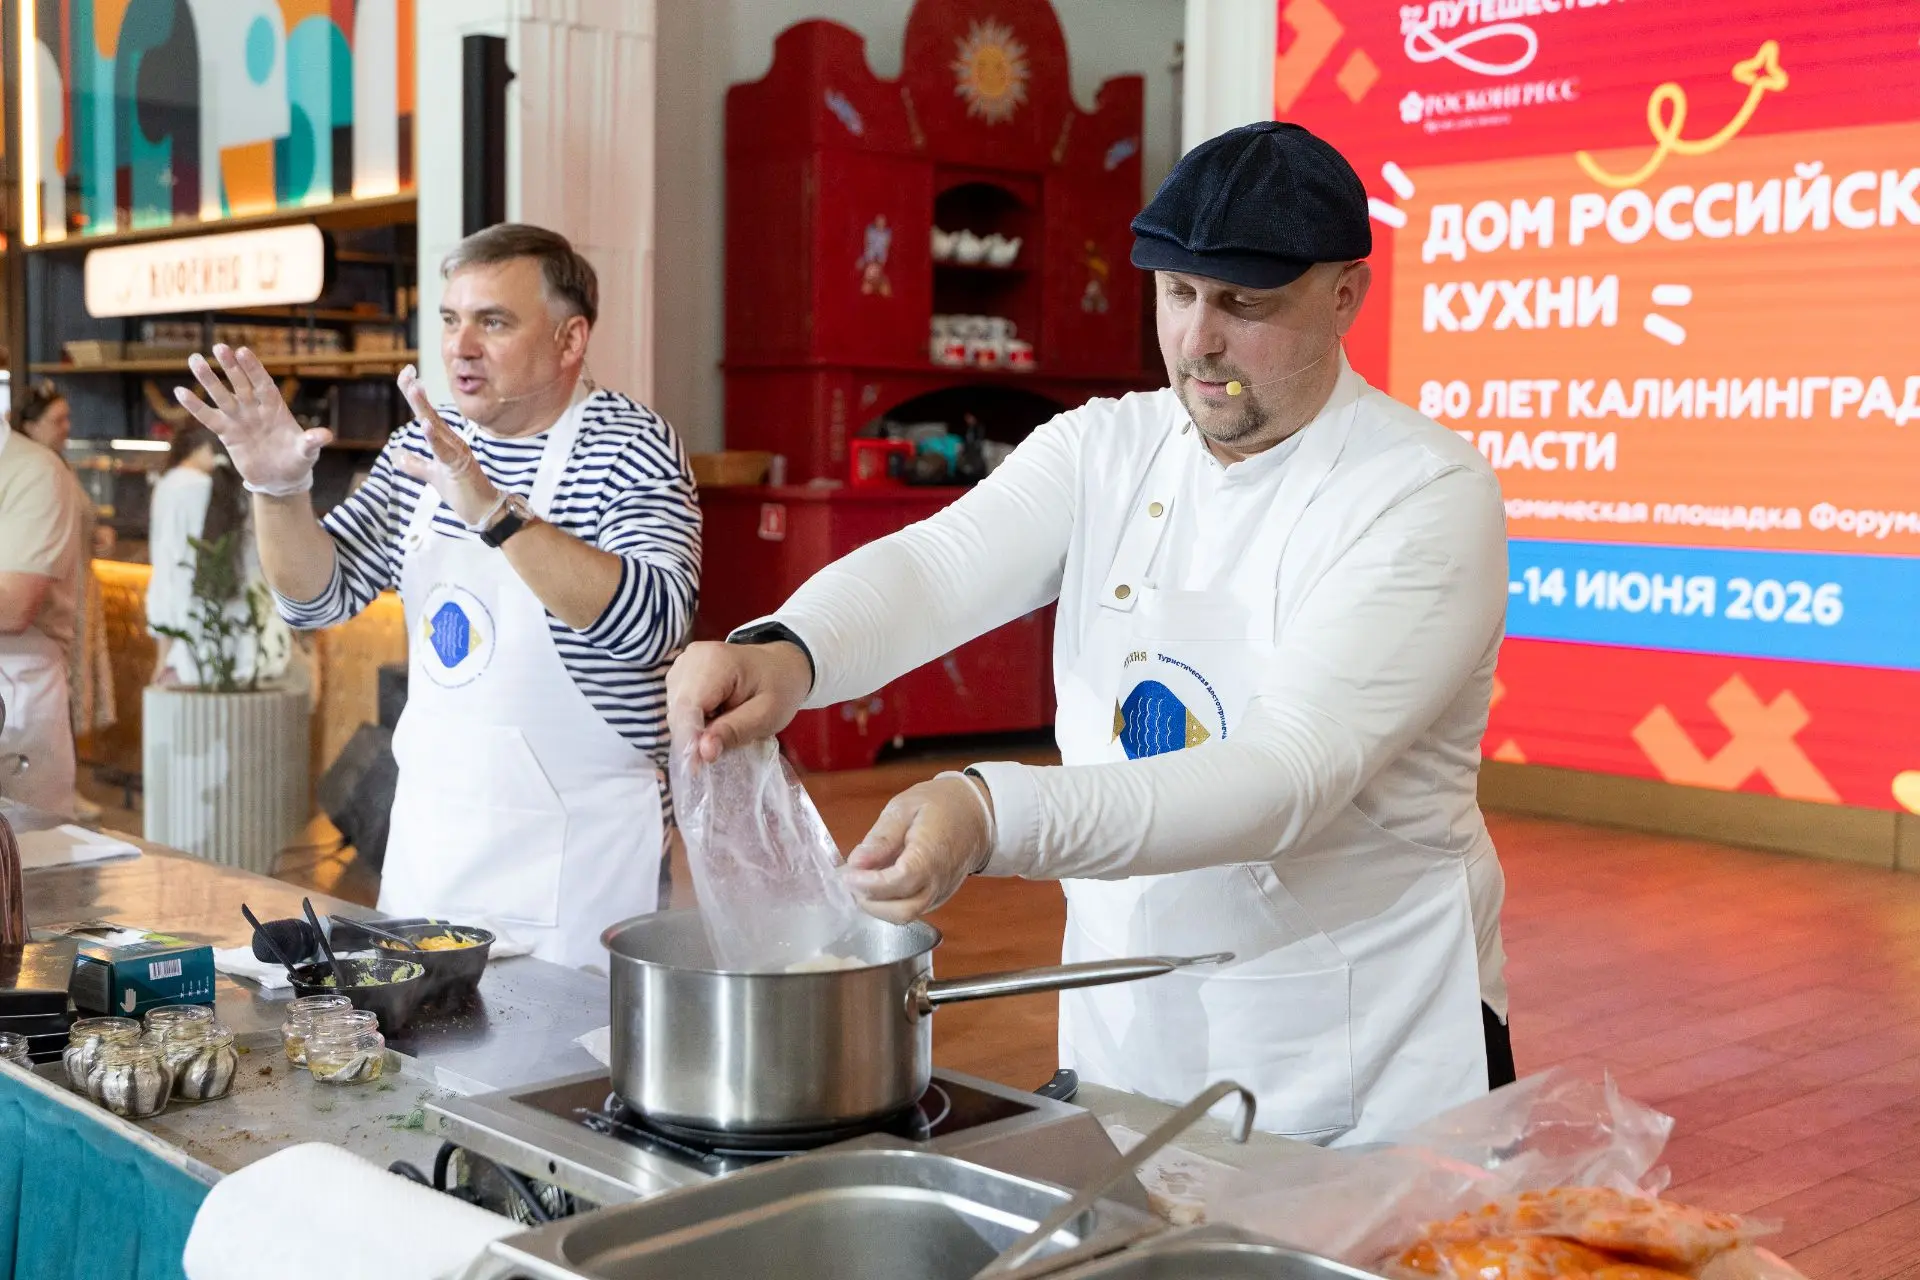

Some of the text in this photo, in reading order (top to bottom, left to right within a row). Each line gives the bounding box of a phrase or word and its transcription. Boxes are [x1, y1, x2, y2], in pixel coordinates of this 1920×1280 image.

[1422, 161, 1920, 263] ДОМ РОССИЙСК
[1422, 275, 1619, 333] КУХНИ
[1419, 379, 1471, 419] 80
[1476, 379, 1561, 419] ЛЕТ
[1456, 429, 1618, 471] ЛАСТИ
[1653, 503, 1802, 531] площадка
[1575, 569, 1717, 617] ИЮНЯ
[1725, 577, 1844, 627] 2026
